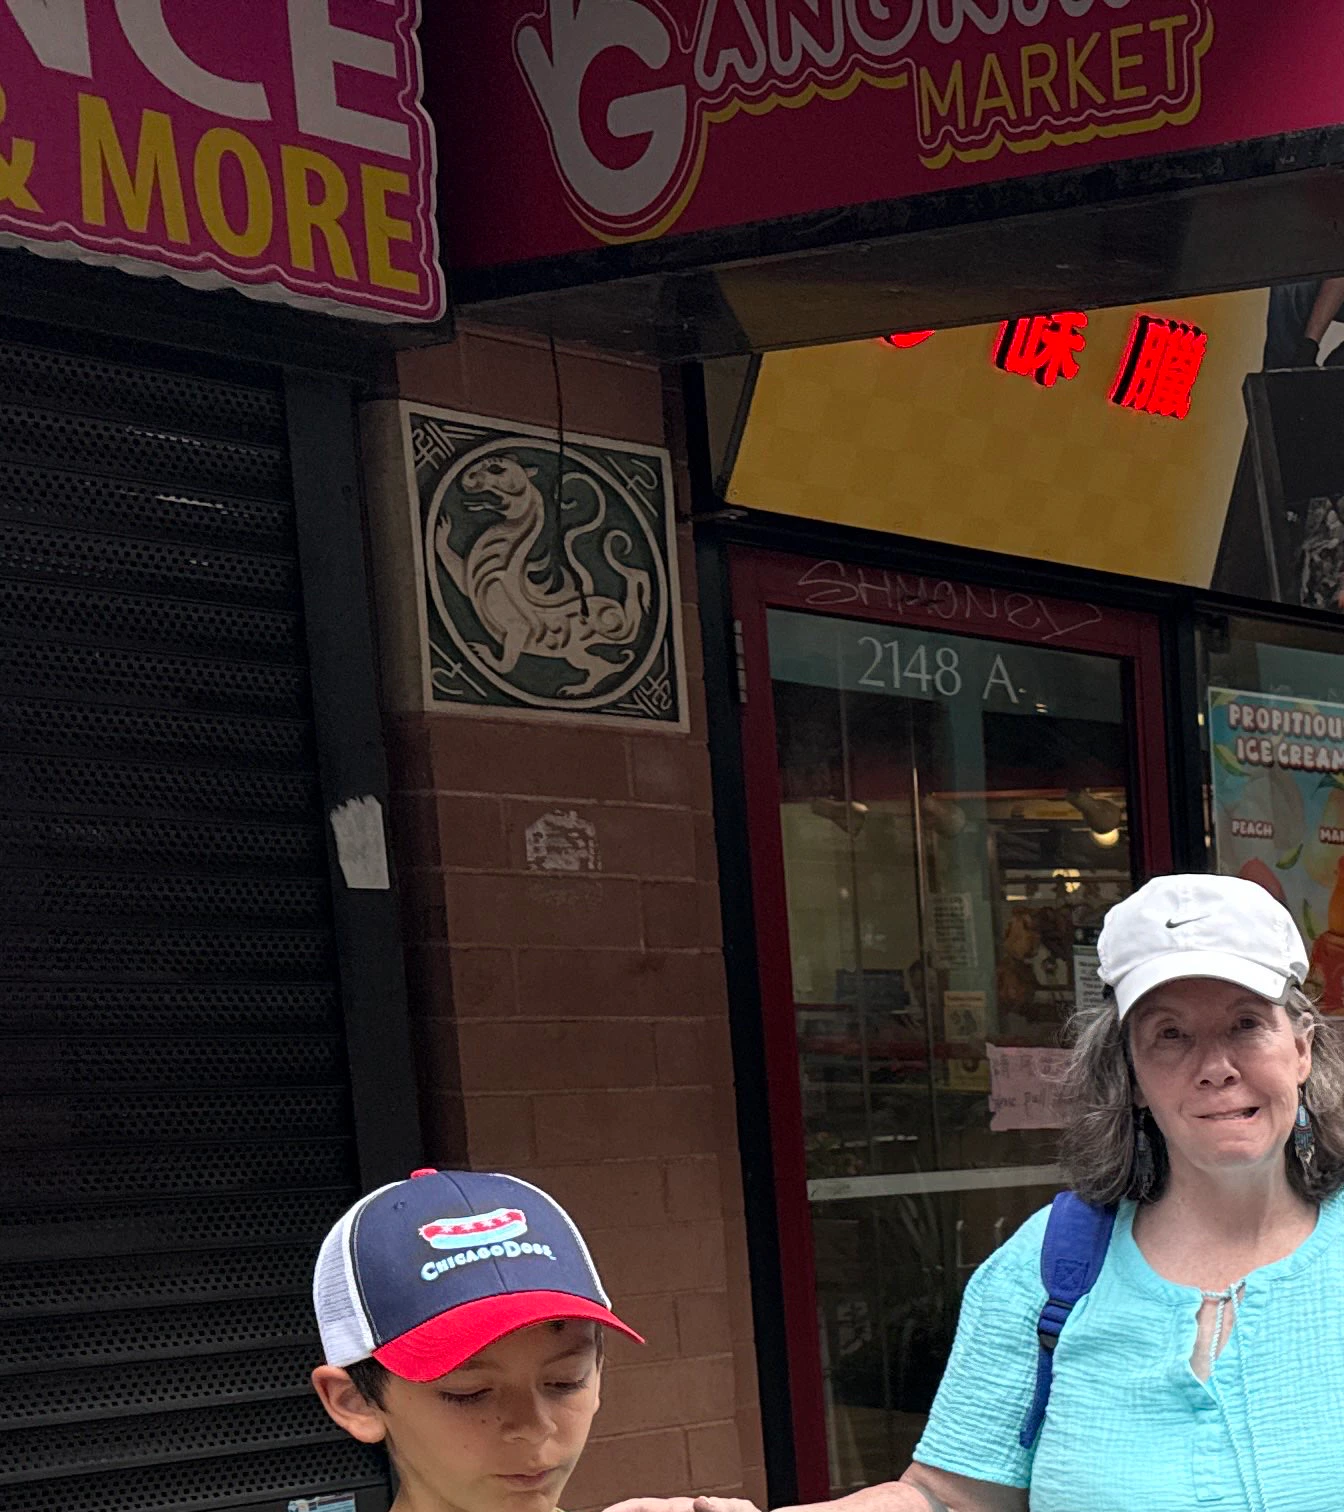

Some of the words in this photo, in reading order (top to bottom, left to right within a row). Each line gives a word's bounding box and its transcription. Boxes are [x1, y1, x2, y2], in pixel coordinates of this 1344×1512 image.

[918, 14, 1188, 136] MARKET
[78, 92, 421, 295] MORE
[858, 636, 962, 697] 2148
[1236, 736, 1273, 767] ICE
[1231, 819, 1274, 839] PEACH
